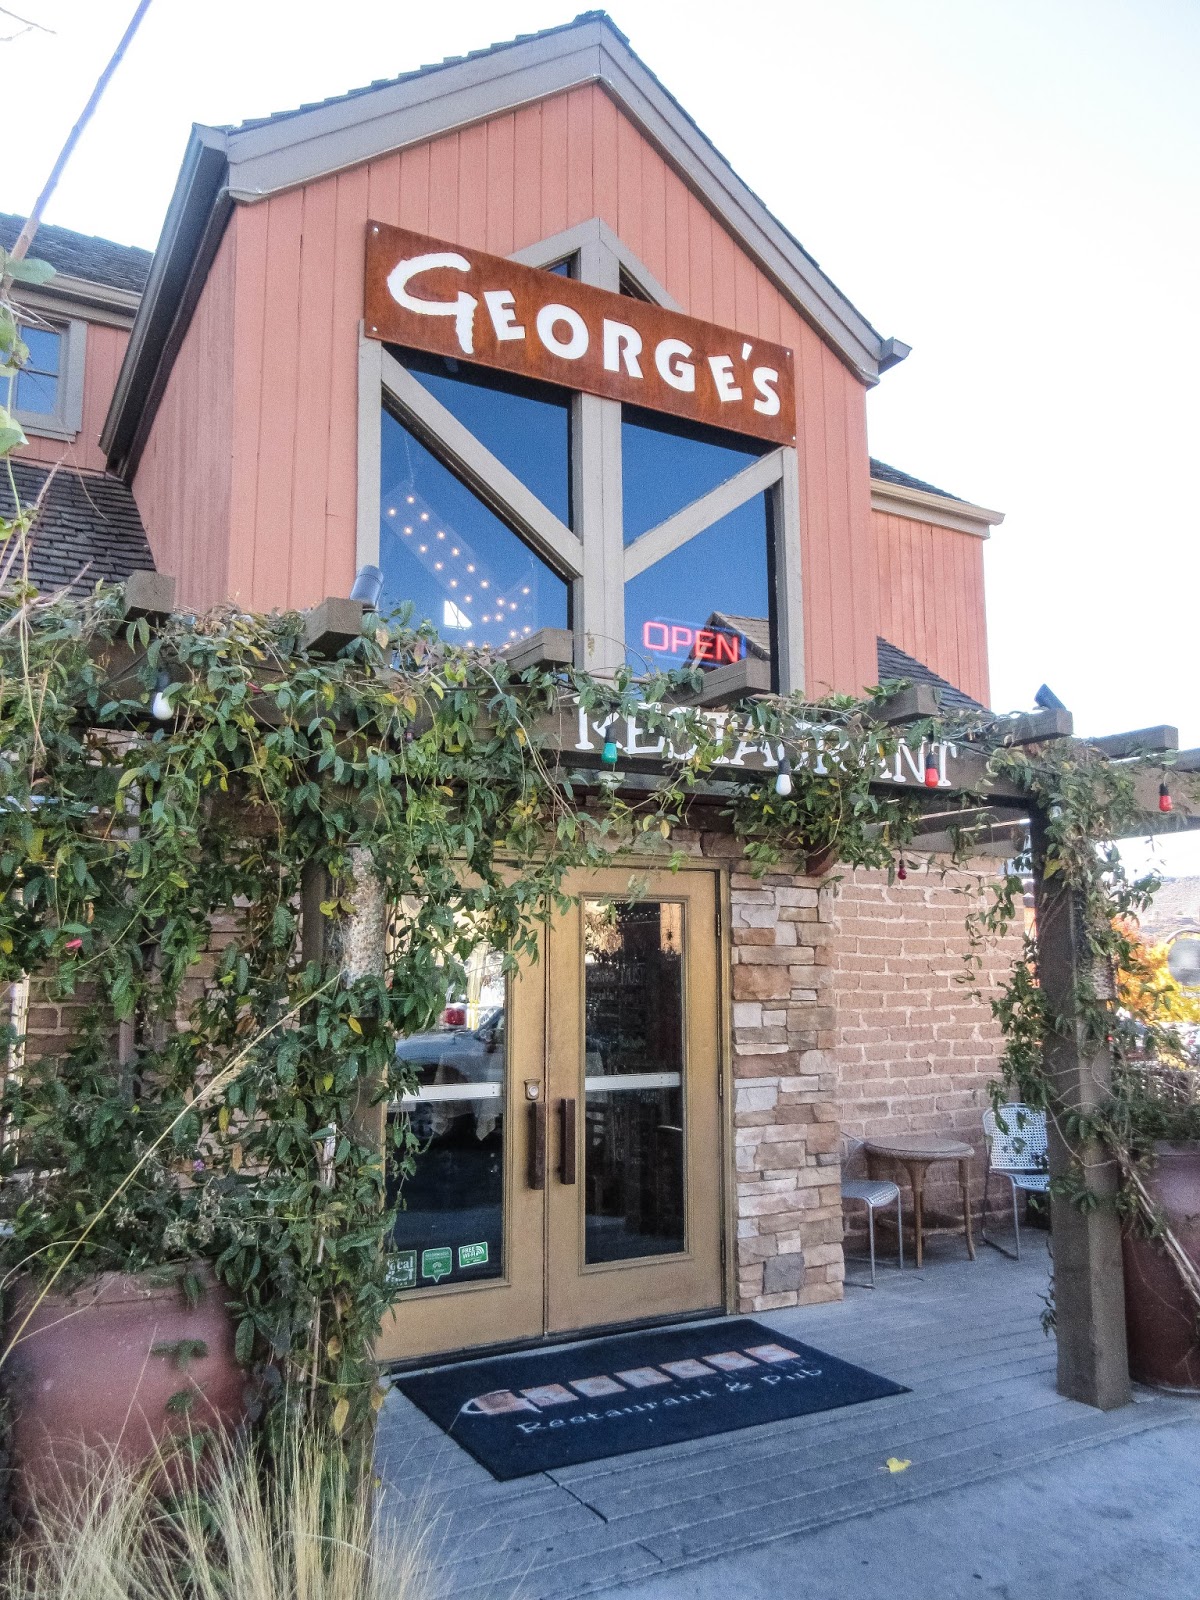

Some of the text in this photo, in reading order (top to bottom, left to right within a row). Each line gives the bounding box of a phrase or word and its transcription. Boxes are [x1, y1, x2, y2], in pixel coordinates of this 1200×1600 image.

[387, 252, 781, 416] GEORGE'S
[642, 621, 740, 662] OPEN
[573, 696, 957, 786] RESTARNT
[462, 1246, 475, 1254] FREE
[516, 1388, 717, 1434] Restaurant
[725, 1381, 753, 1393] &
[760, 1368, 823, 1386] Pub
